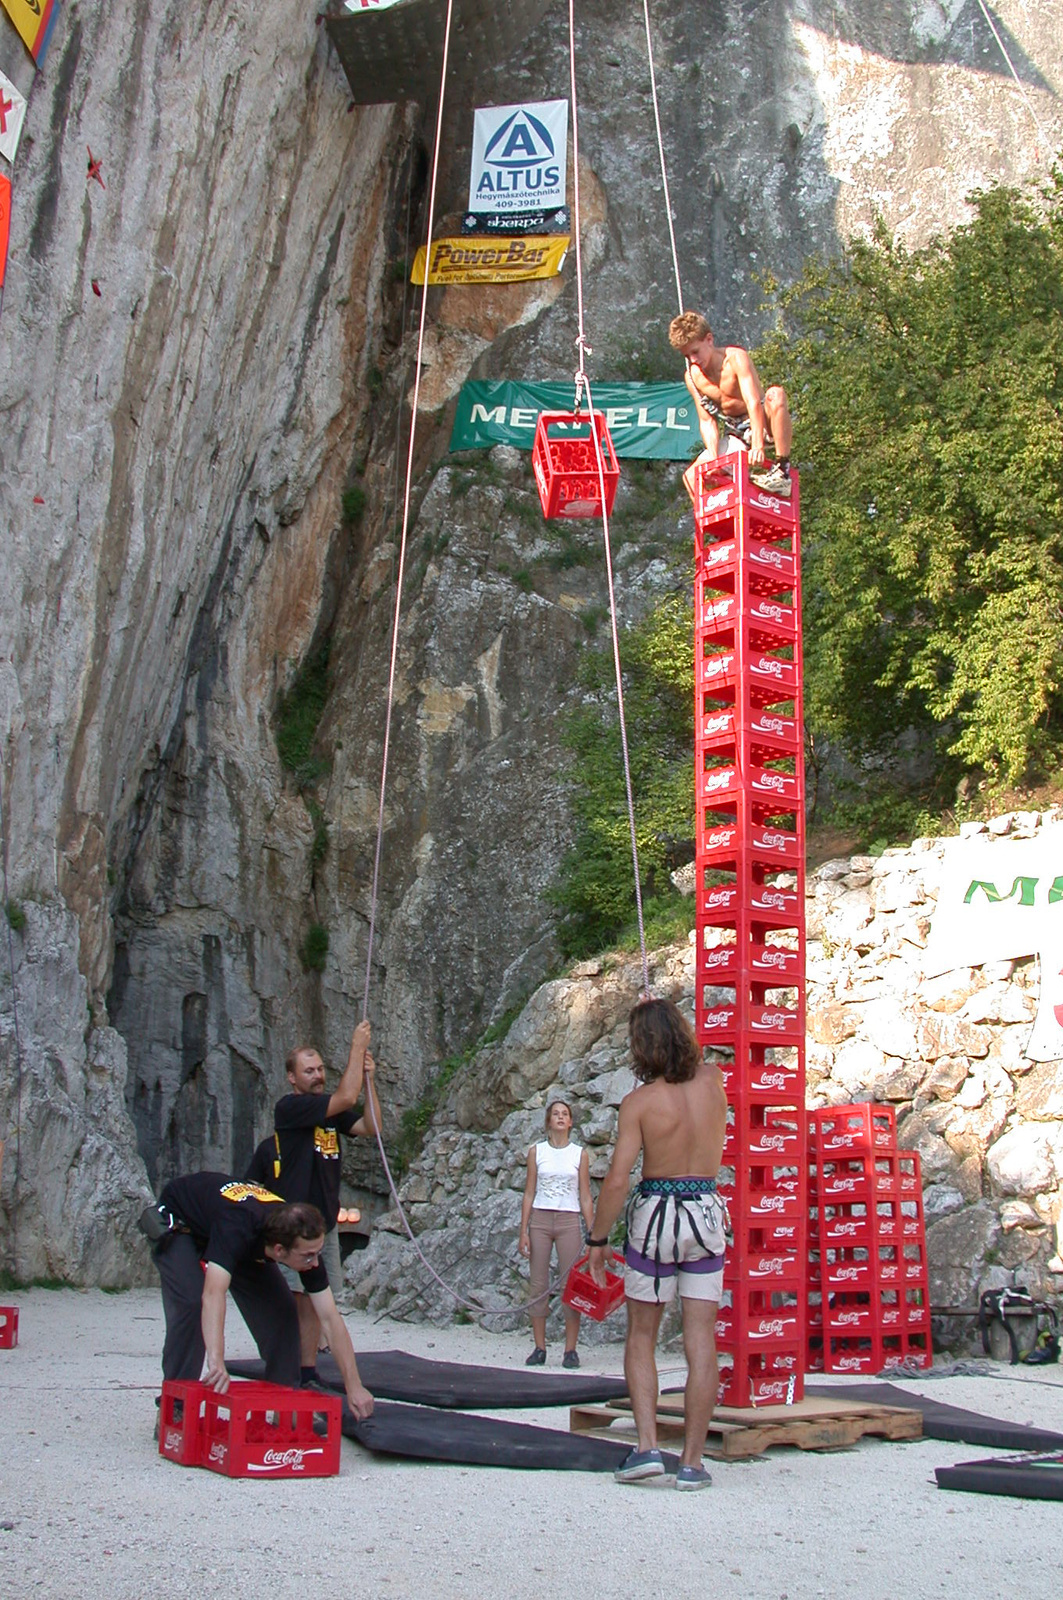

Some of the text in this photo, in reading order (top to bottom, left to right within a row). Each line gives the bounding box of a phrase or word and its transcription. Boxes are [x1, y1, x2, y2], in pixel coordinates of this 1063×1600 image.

[501, 123, 538, 157] A
[477, 166, 560, 192] ALTUS
[475, 188, 560, 200] Hegymászótechnika
[495, 199, 541, 208] 409-3981
[487, 216, 544, 228] sherpa
[431, 240, 550, 273] PowerBar
